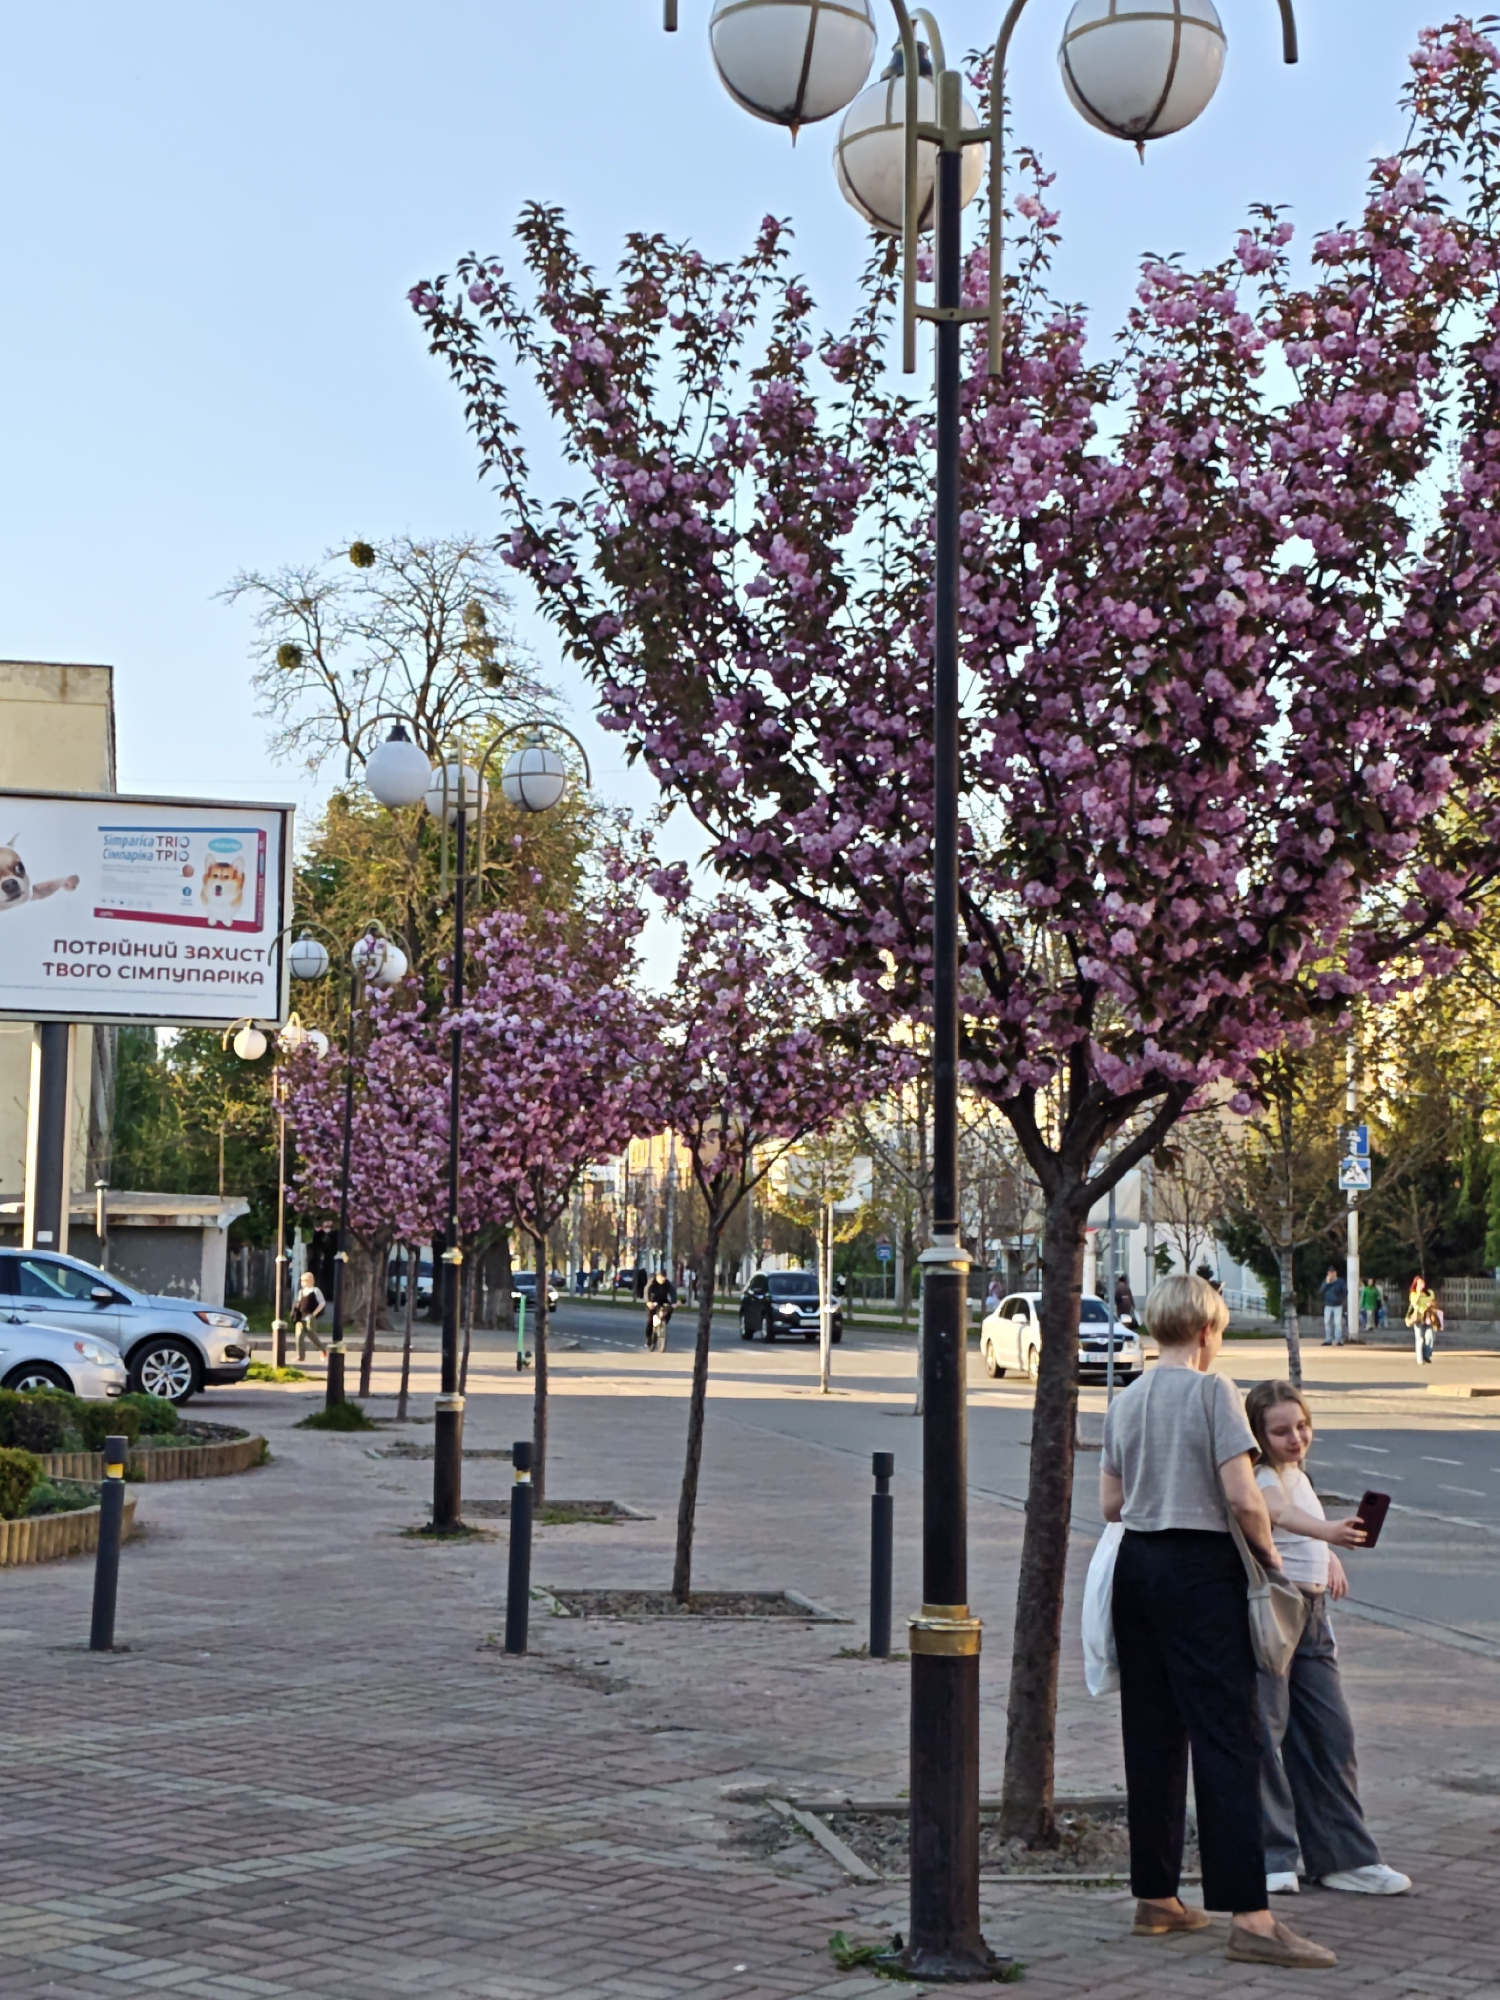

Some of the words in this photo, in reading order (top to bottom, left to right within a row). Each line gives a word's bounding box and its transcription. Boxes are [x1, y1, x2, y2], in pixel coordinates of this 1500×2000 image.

[103, 834, 153, 849] Simparica
[156, 835, 190, 848] TRIO
[102, 848, 153, 863] Сімпаріка
[156, 849, 189, 862] ТРІО
[54, 938, 178, 959] ПОТРІЙНИЙ
[184, 945, 265, 962] ЗАХИСТ
[42, 961, 111, 979] ТВОГО
[117, 965, 264, 985] СІМПУПАРІКА
